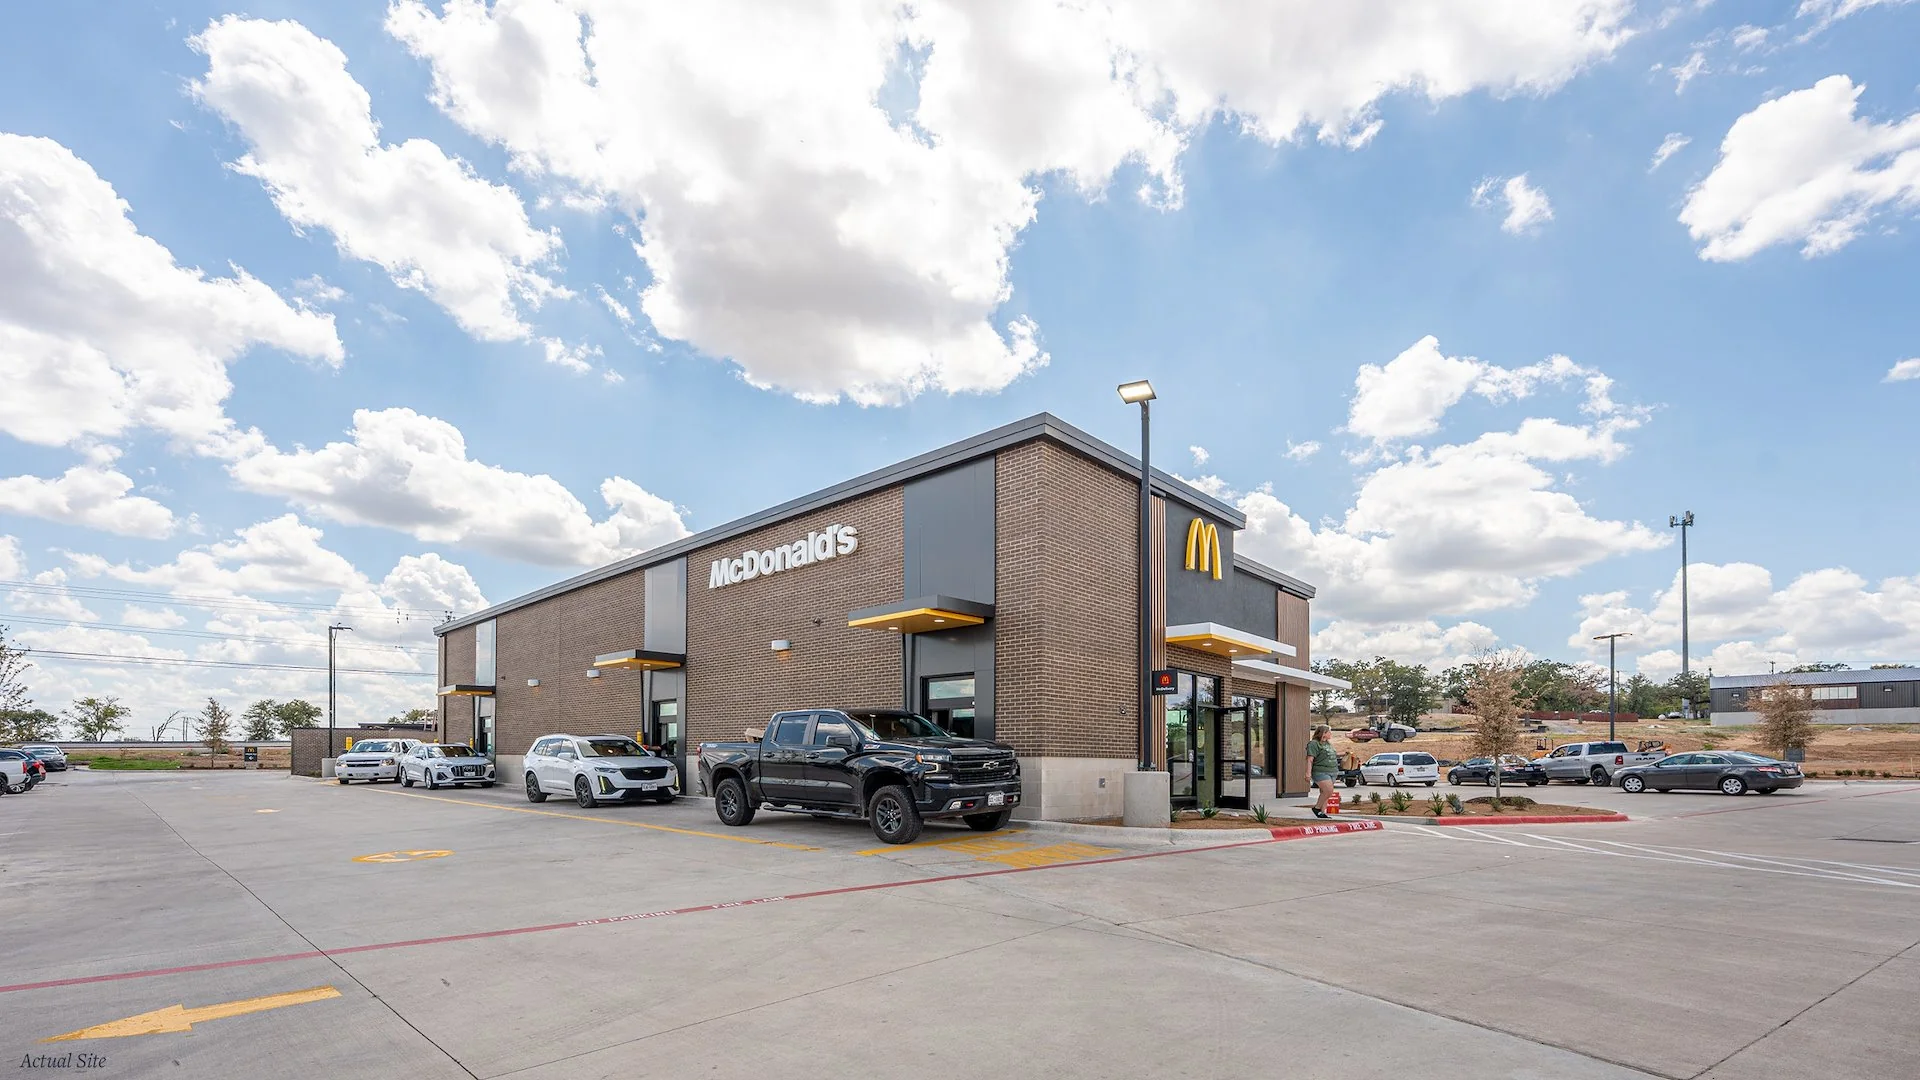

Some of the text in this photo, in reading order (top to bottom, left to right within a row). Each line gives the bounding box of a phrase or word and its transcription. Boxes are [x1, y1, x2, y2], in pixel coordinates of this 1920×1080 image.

[708, 523, 859, 589] McDonald's
[1303, 821, 1378, 835] NO PARKING FIRE LANE
